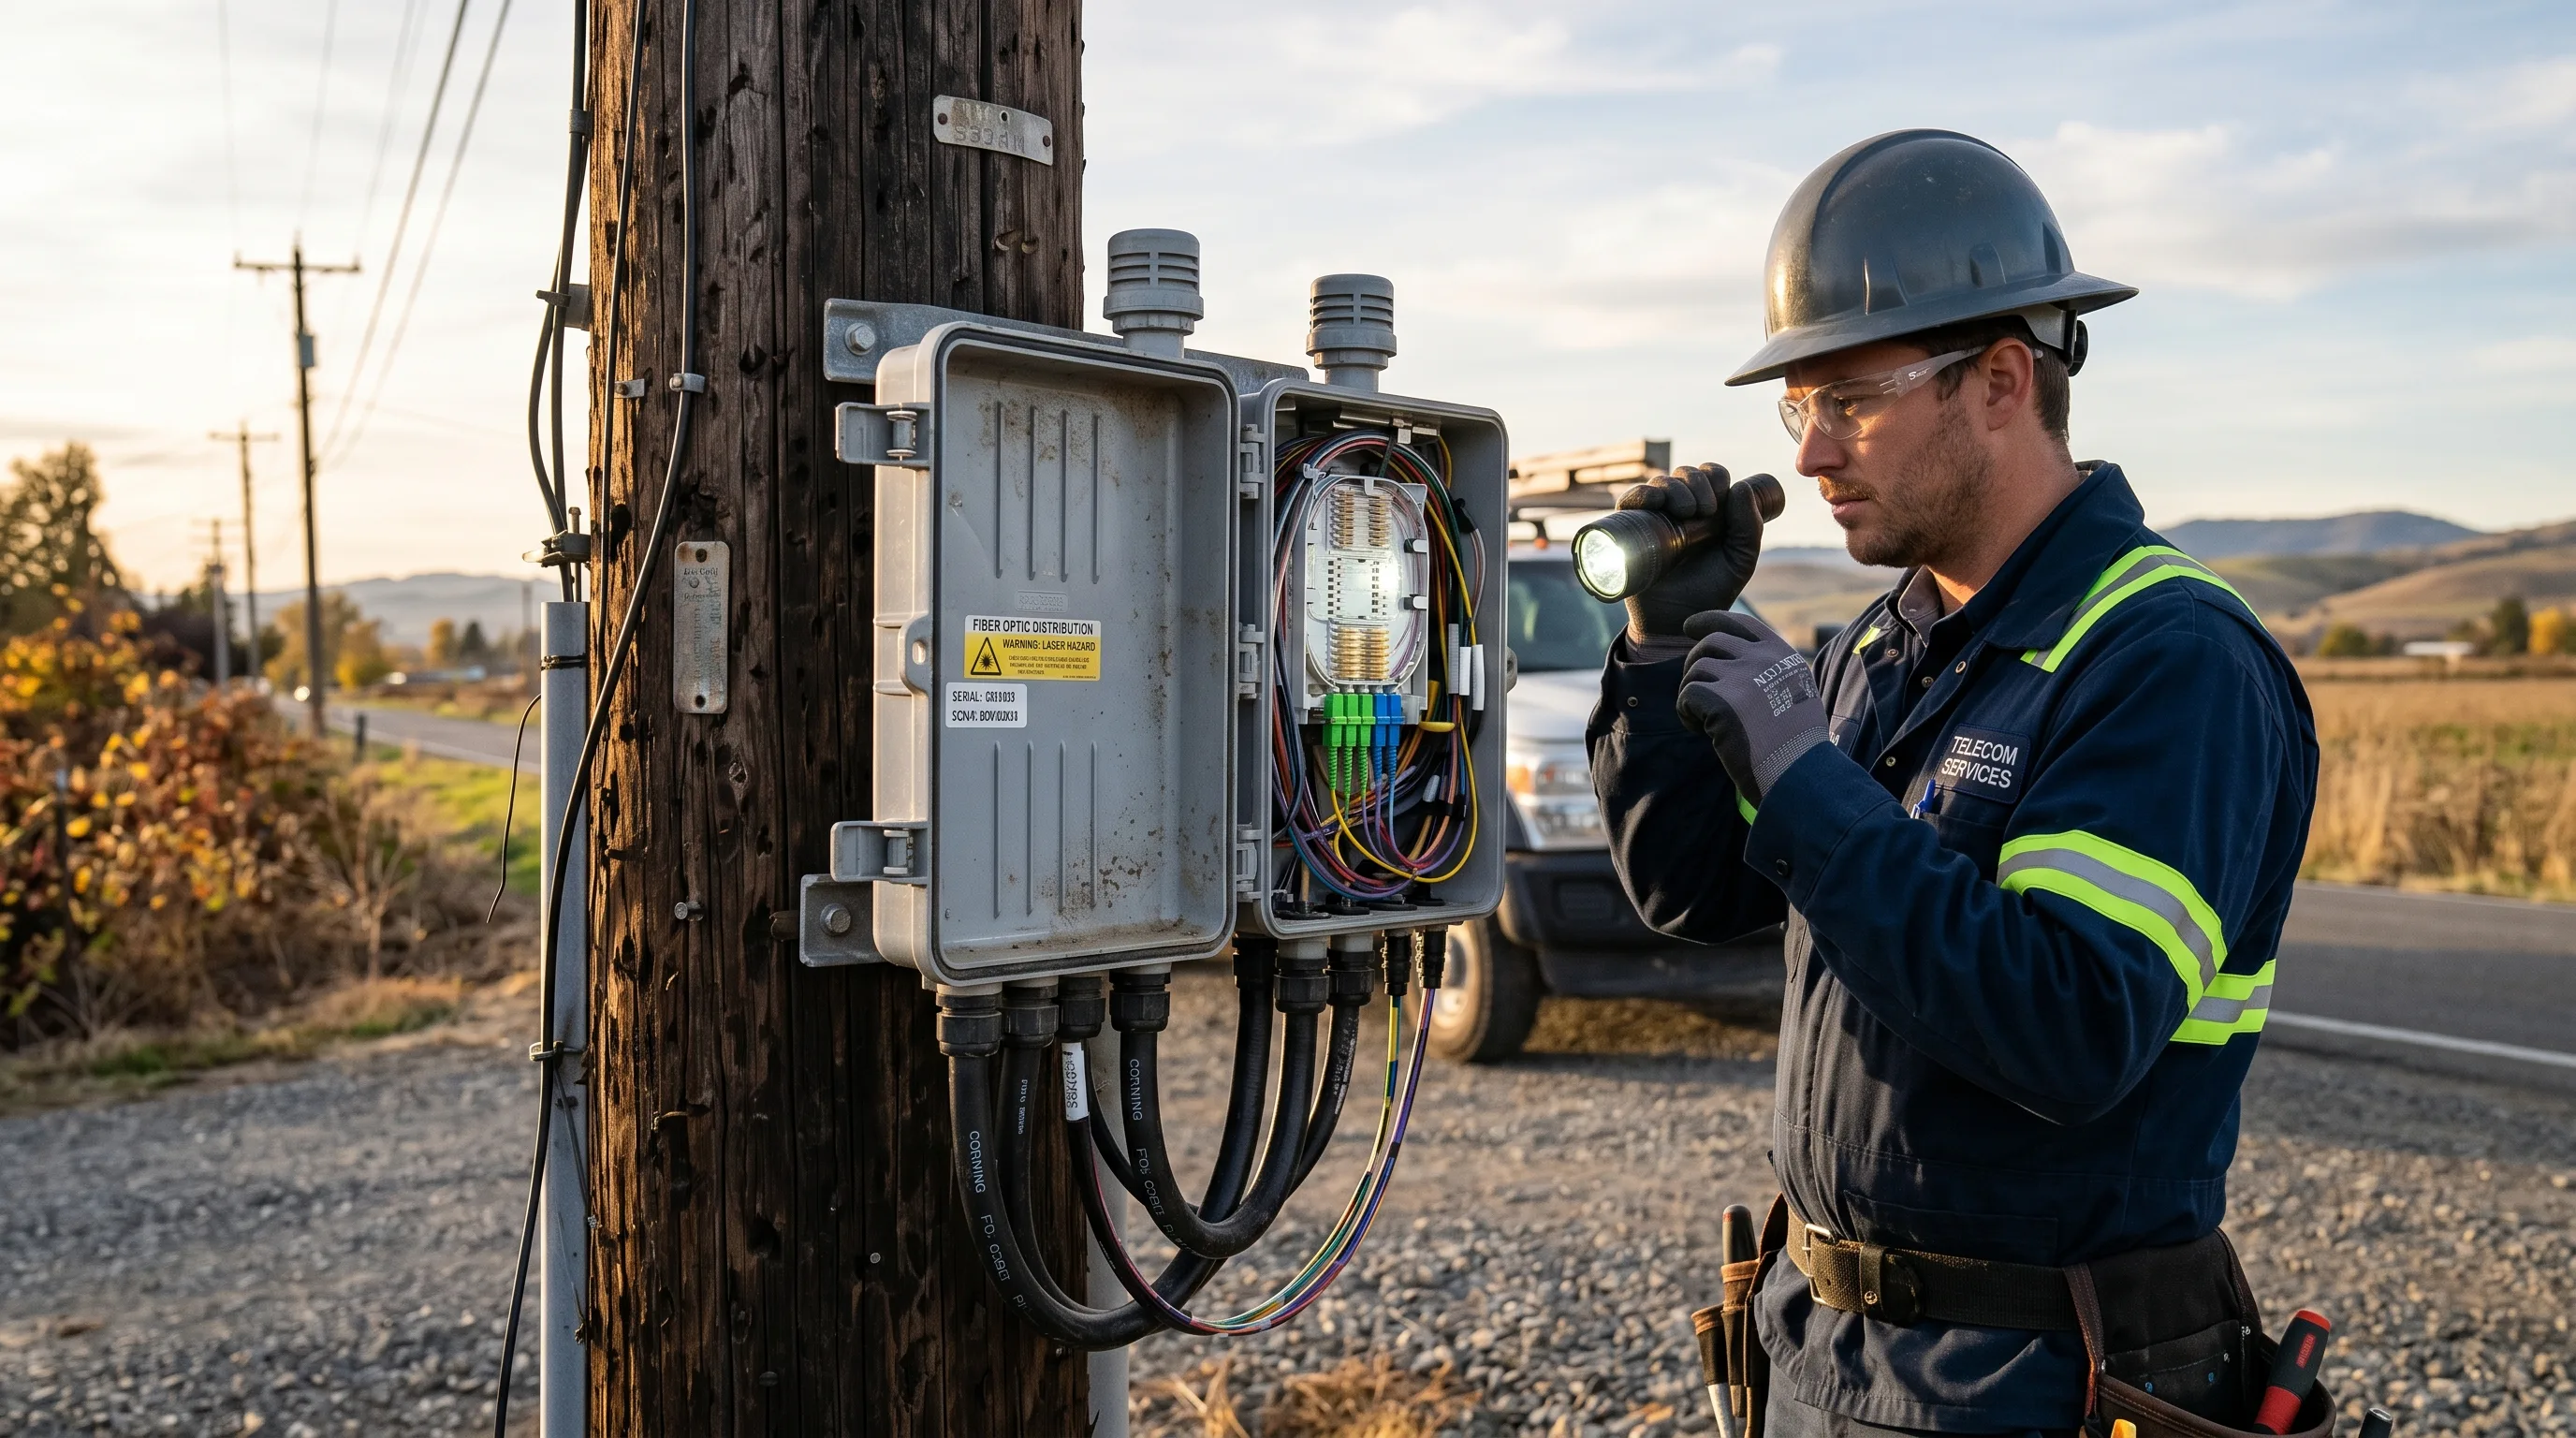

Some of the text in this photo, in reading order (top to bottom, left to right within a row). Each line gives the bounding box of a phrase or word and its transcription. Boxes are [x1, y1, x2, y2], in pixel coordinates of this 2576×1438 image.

[973, 618, 1093, 636] FIBER OPTIC DISTRIBUTION
[1003, 638, 1096, 652] WARNING: LASER HAZARD
[952, 691, 982, 702] SERIAL:
[1951, 735, 2019, 766] TELECOM
[1940, 757, 2012, 788] SERVICES
[1129, 1058, 1143, 1121] CORNING
[969, 1130, 986, 1194] CORNING
